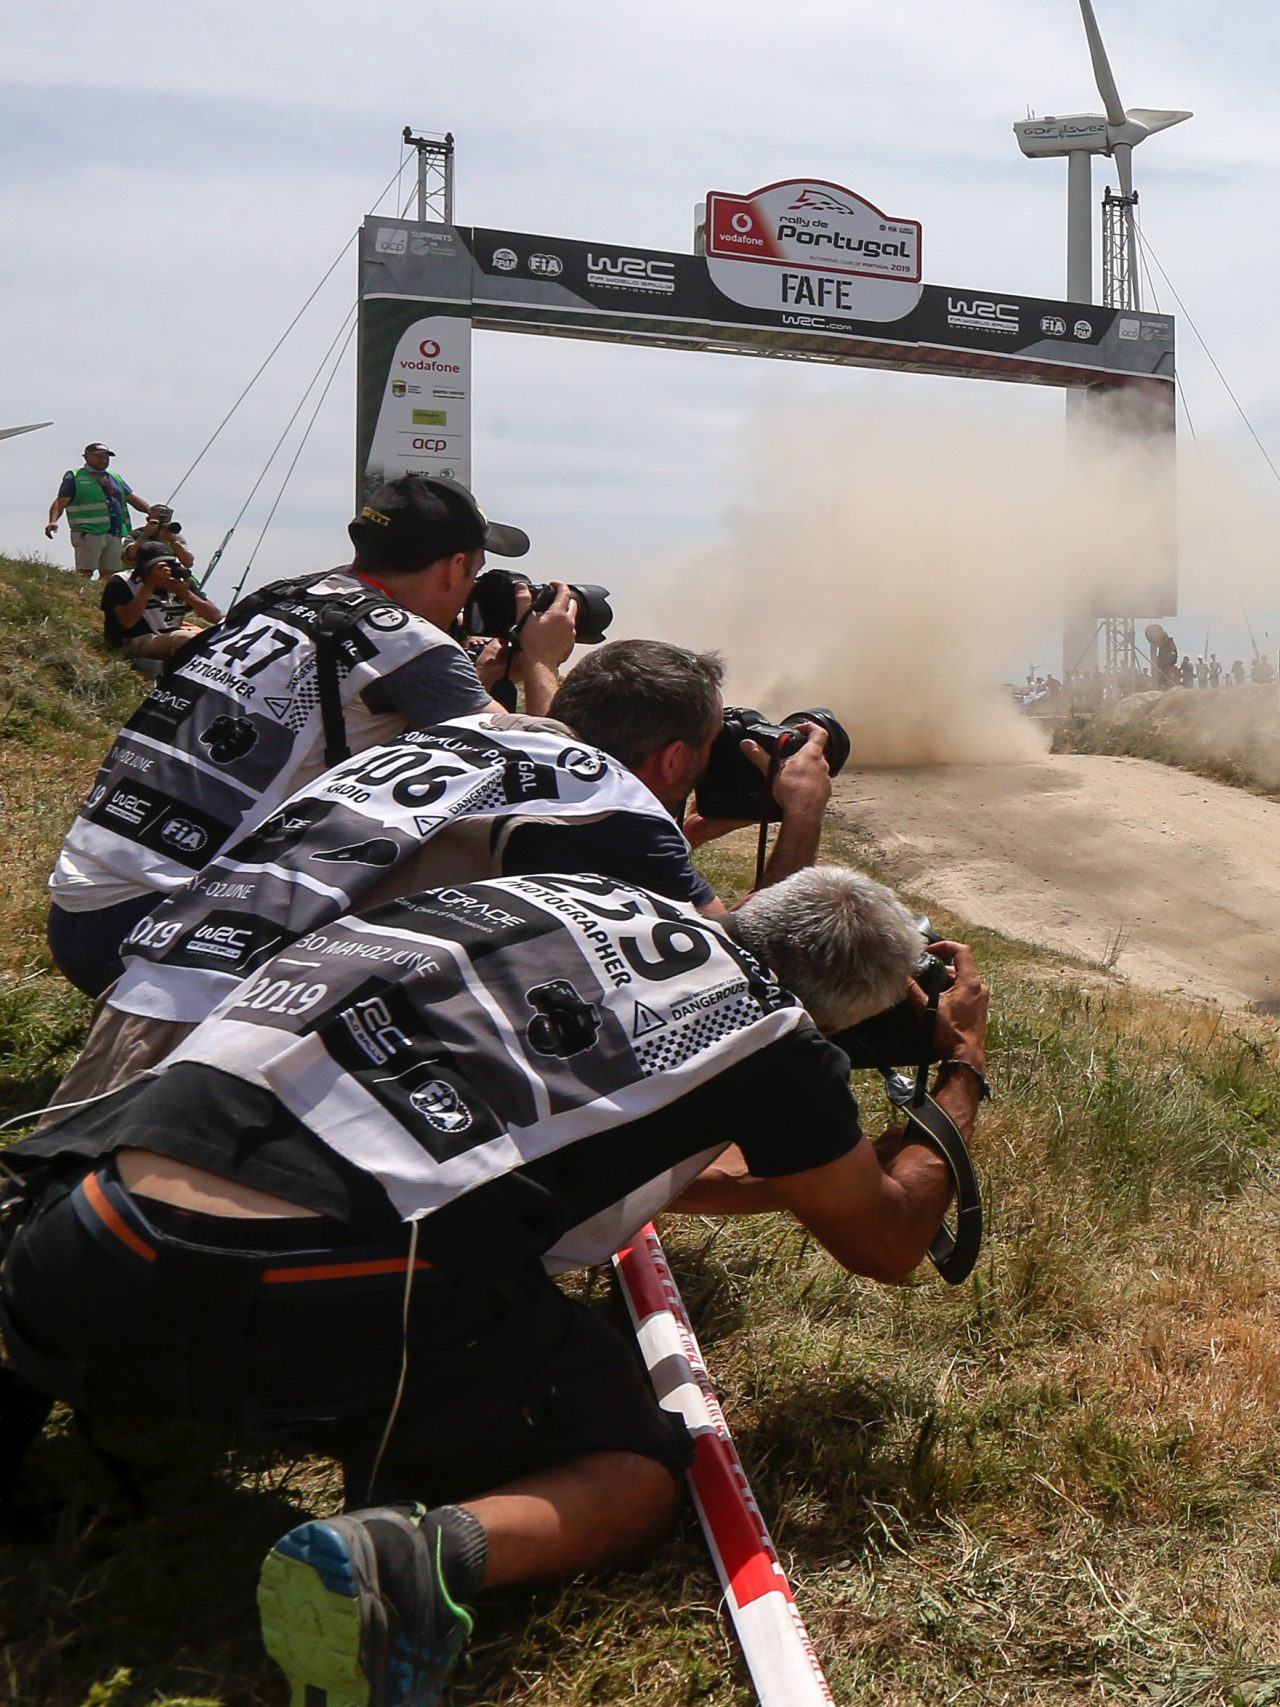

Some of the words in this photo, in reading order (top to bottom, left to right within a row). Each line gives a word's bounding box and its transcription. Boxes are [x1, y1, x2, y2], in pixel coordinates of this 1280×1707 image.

[779, 216, 810, 228] rally
[812, 218, 829, 229] de
[411, 231, 453, 242] SUPPORTS
[719, 234, 764, 247] vodafone
[776, 225, 911, 258] Portugal
[587, 253, 675, 280] WRC
[890, 264, 911, 273] 2019
[781, 273, 853, 311] FAFE
[948, 297, 1019, 321] WRC
[400, 360, 460, 373] vodafone
[412, 438, 447, 453] acp
[111, 788, 152, 816] WRC
[121, 916, 183, 949] 019
[194, 925, 253, 948] WRC
[295, 932, 328, 951] 30
[382, 949, 441, 978] JUNE
[235, 977, 329, 1015] 2019
[671, 982, 747, 1022] DANGEROUS
